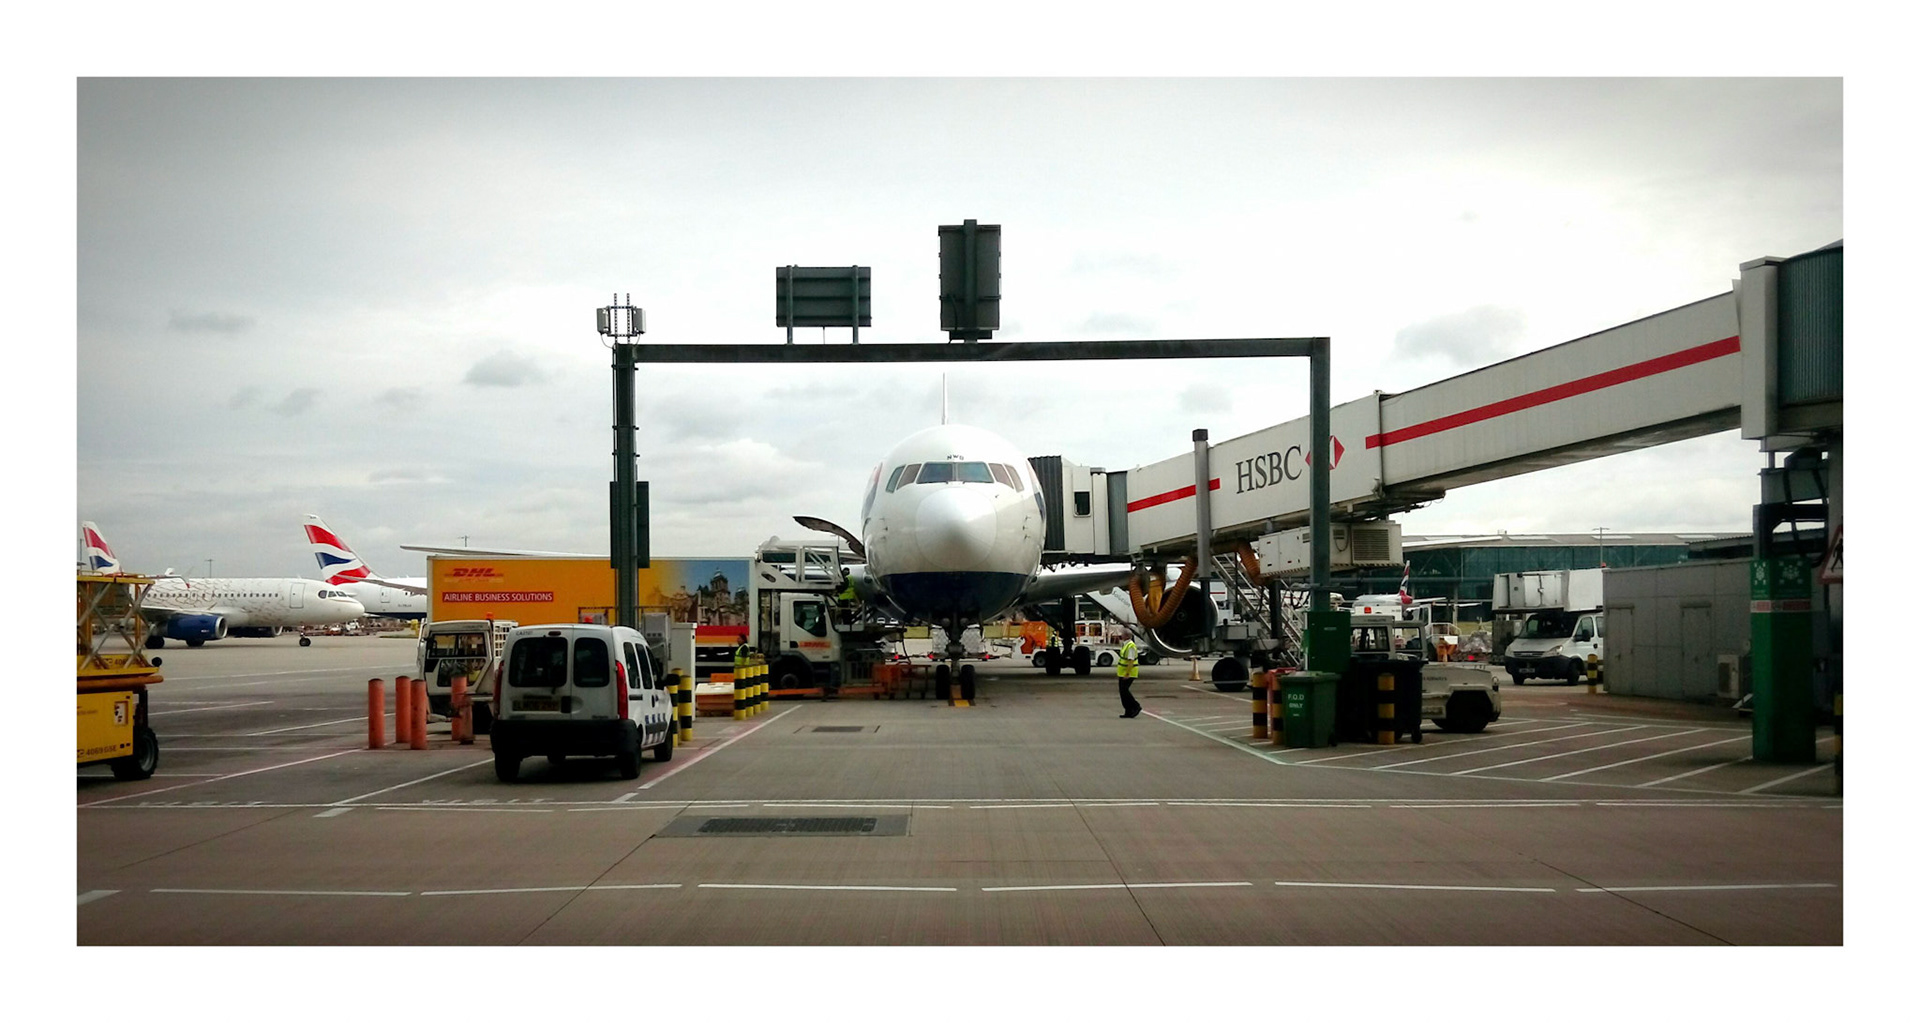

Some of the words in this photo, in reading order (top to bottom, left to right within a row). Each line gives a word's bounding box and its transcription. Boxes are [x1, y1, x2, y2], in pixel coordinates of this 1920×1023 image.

[1235, 444, 1303, 494] HSBC
[452, 567, 497, 577] DHL
[444, 592, 473, 602] AIRLINE
[475, 592, 511, 602] BUSINESS
[511, 592, 553, 602] SOLUTIONS
